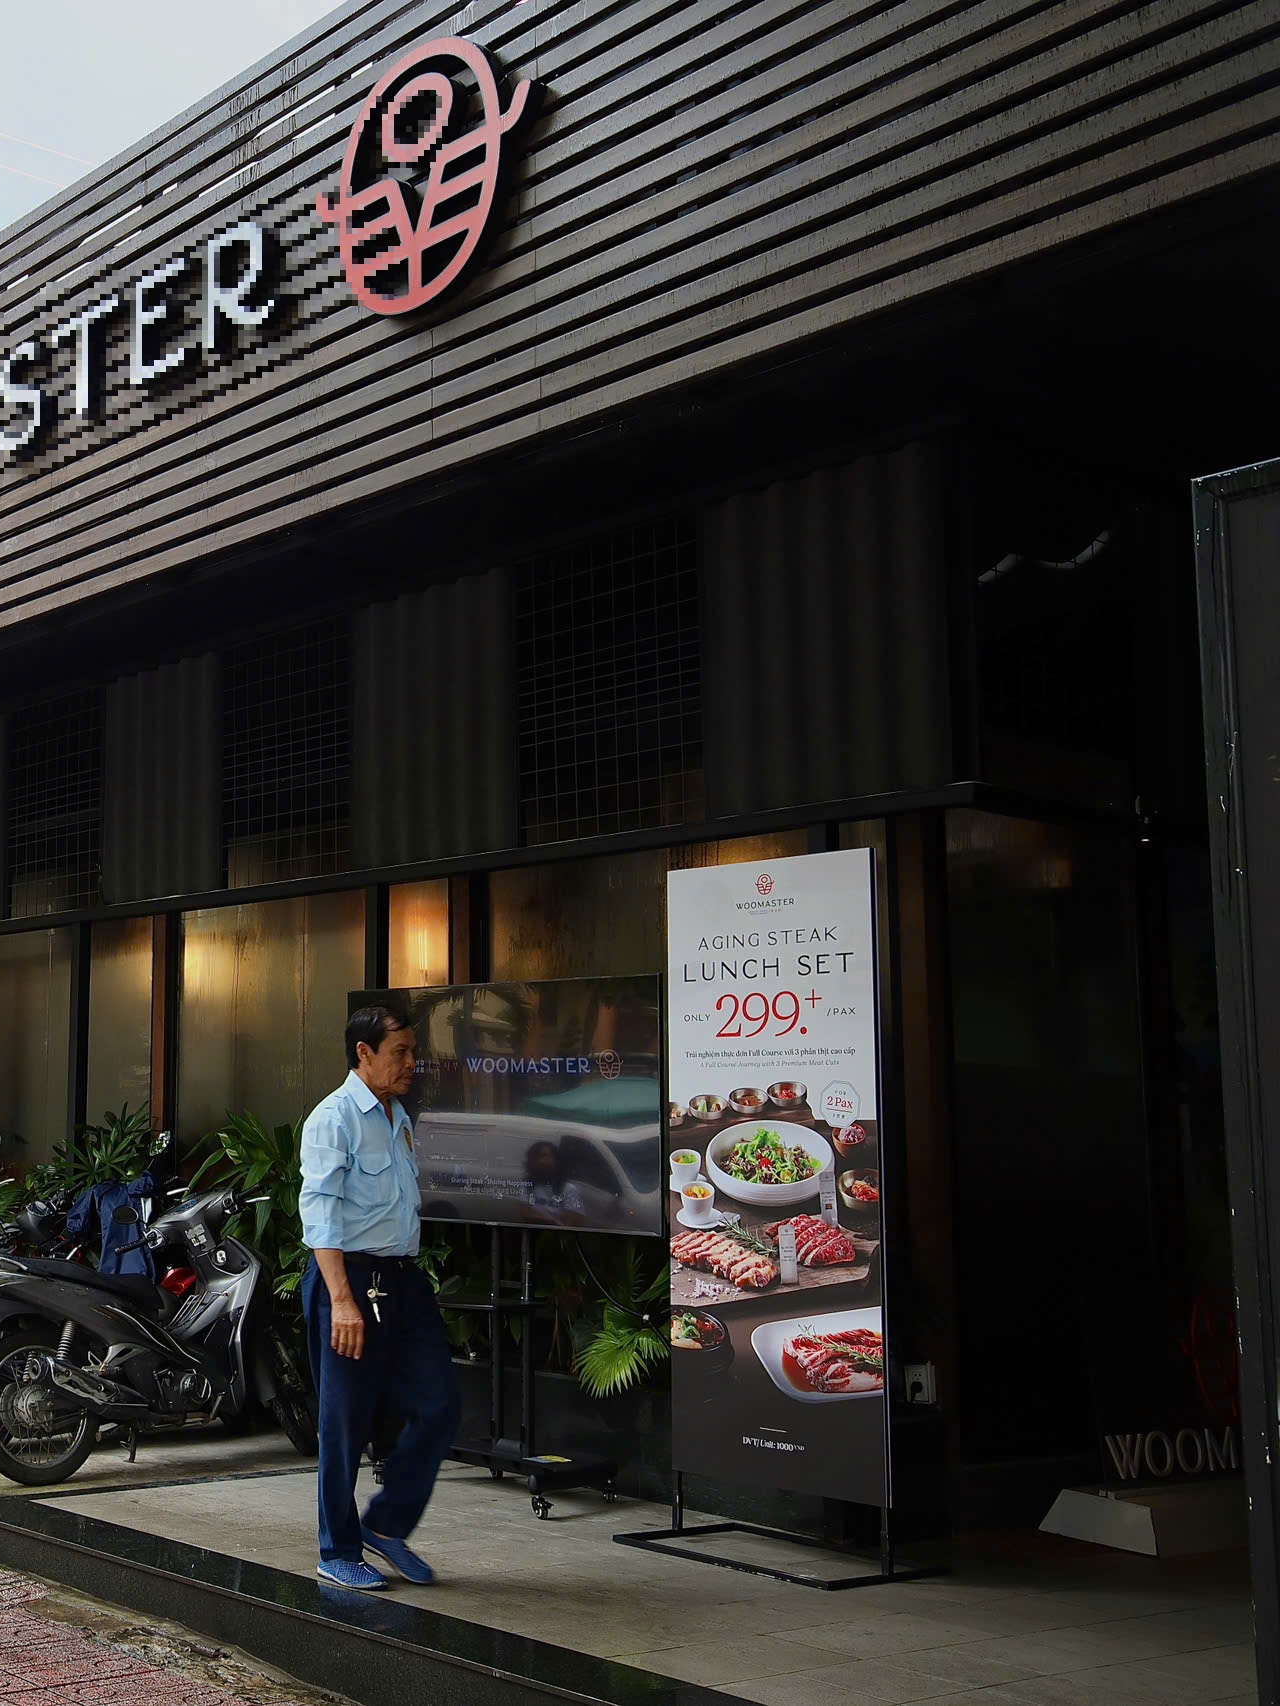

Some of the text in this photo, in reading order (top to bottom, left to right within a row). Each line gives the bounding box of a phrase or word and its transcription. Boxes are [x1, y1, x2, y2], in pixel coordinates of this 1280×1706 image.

[735, 897, 795, 910] WOOMASTER
[697, 926, 838, 951] AGING STEAK
[683, 951, 855, 983] LUNCH SET
[683, 1013, 711, 1023] ONLY
[761, 1049, 784, 1057] Course
[466, 1057, 592, 1074] WOOMASTER
[826, 1096, 854, 1109] 2 Pax
